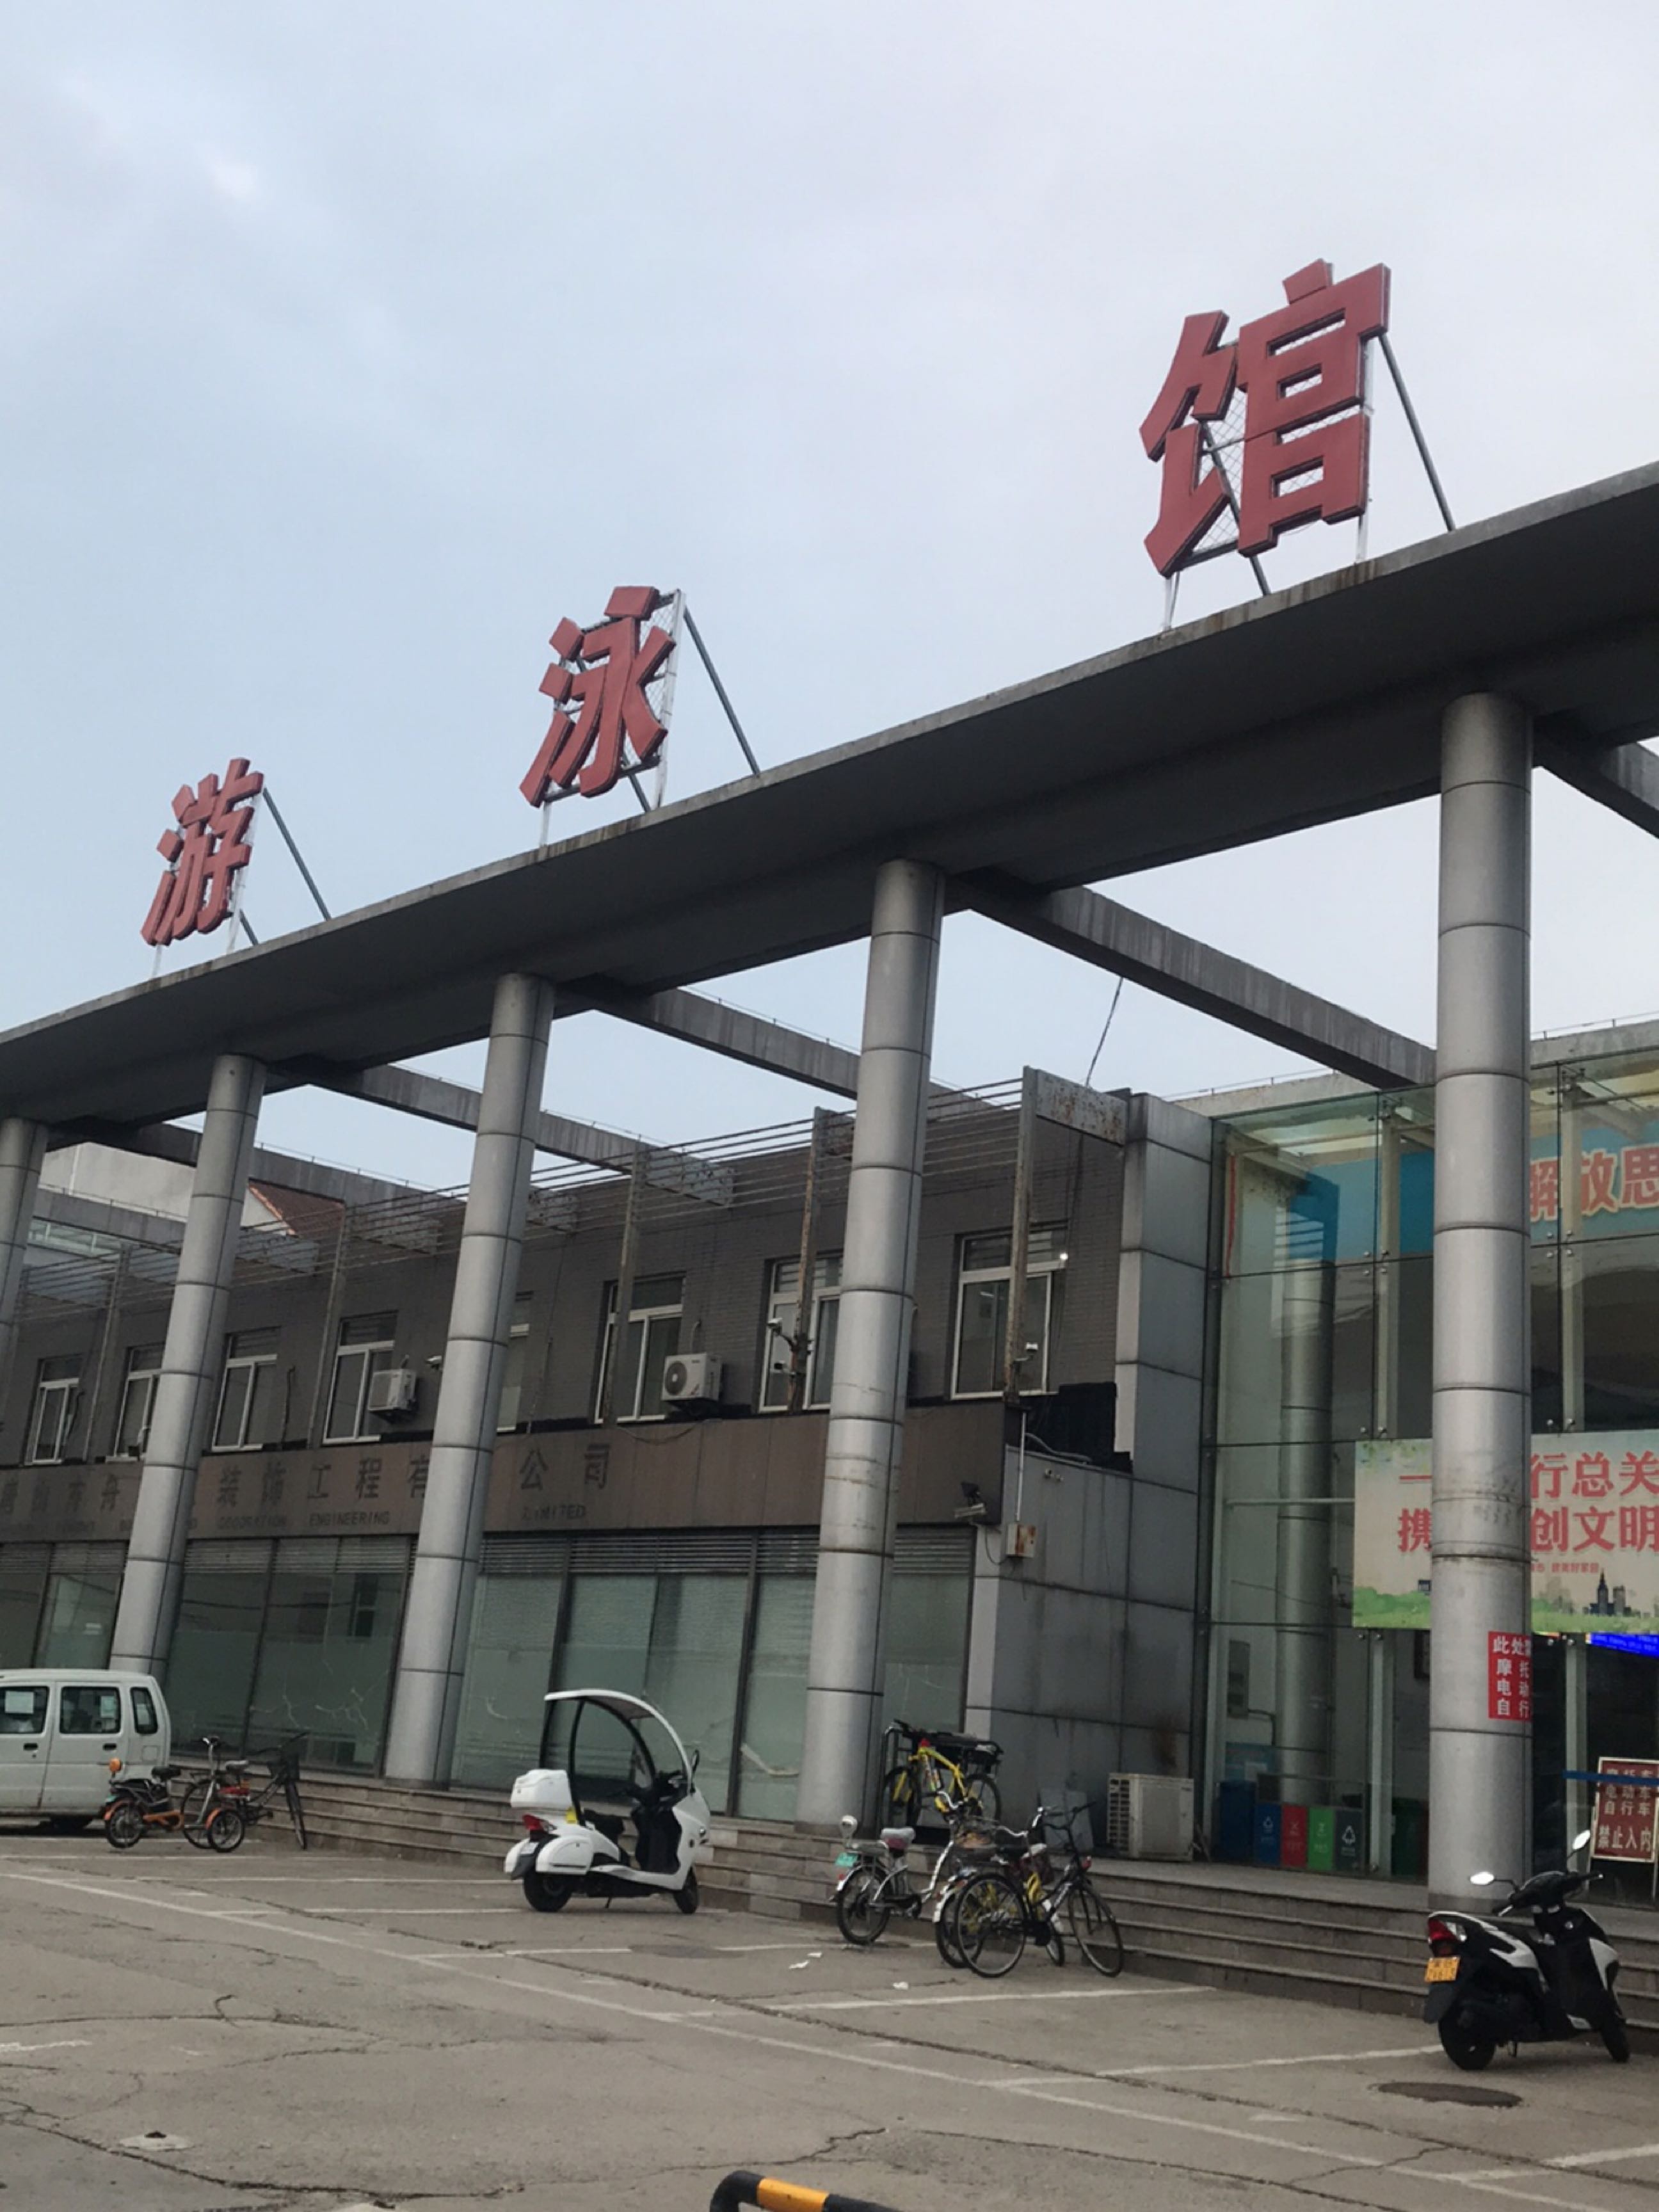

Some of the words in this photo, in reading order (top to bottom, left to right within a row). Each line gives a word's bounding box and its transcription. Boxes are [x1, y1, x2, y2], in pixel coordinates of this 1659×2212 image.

[309, 1511, 390, 1527] ENGINEERING
[521, 1503, 587, 1521] LIMITED
[1604, 1800, 1651, 1816] 自行车
[1598, 1825, 1652, 1852] 禁止入内
